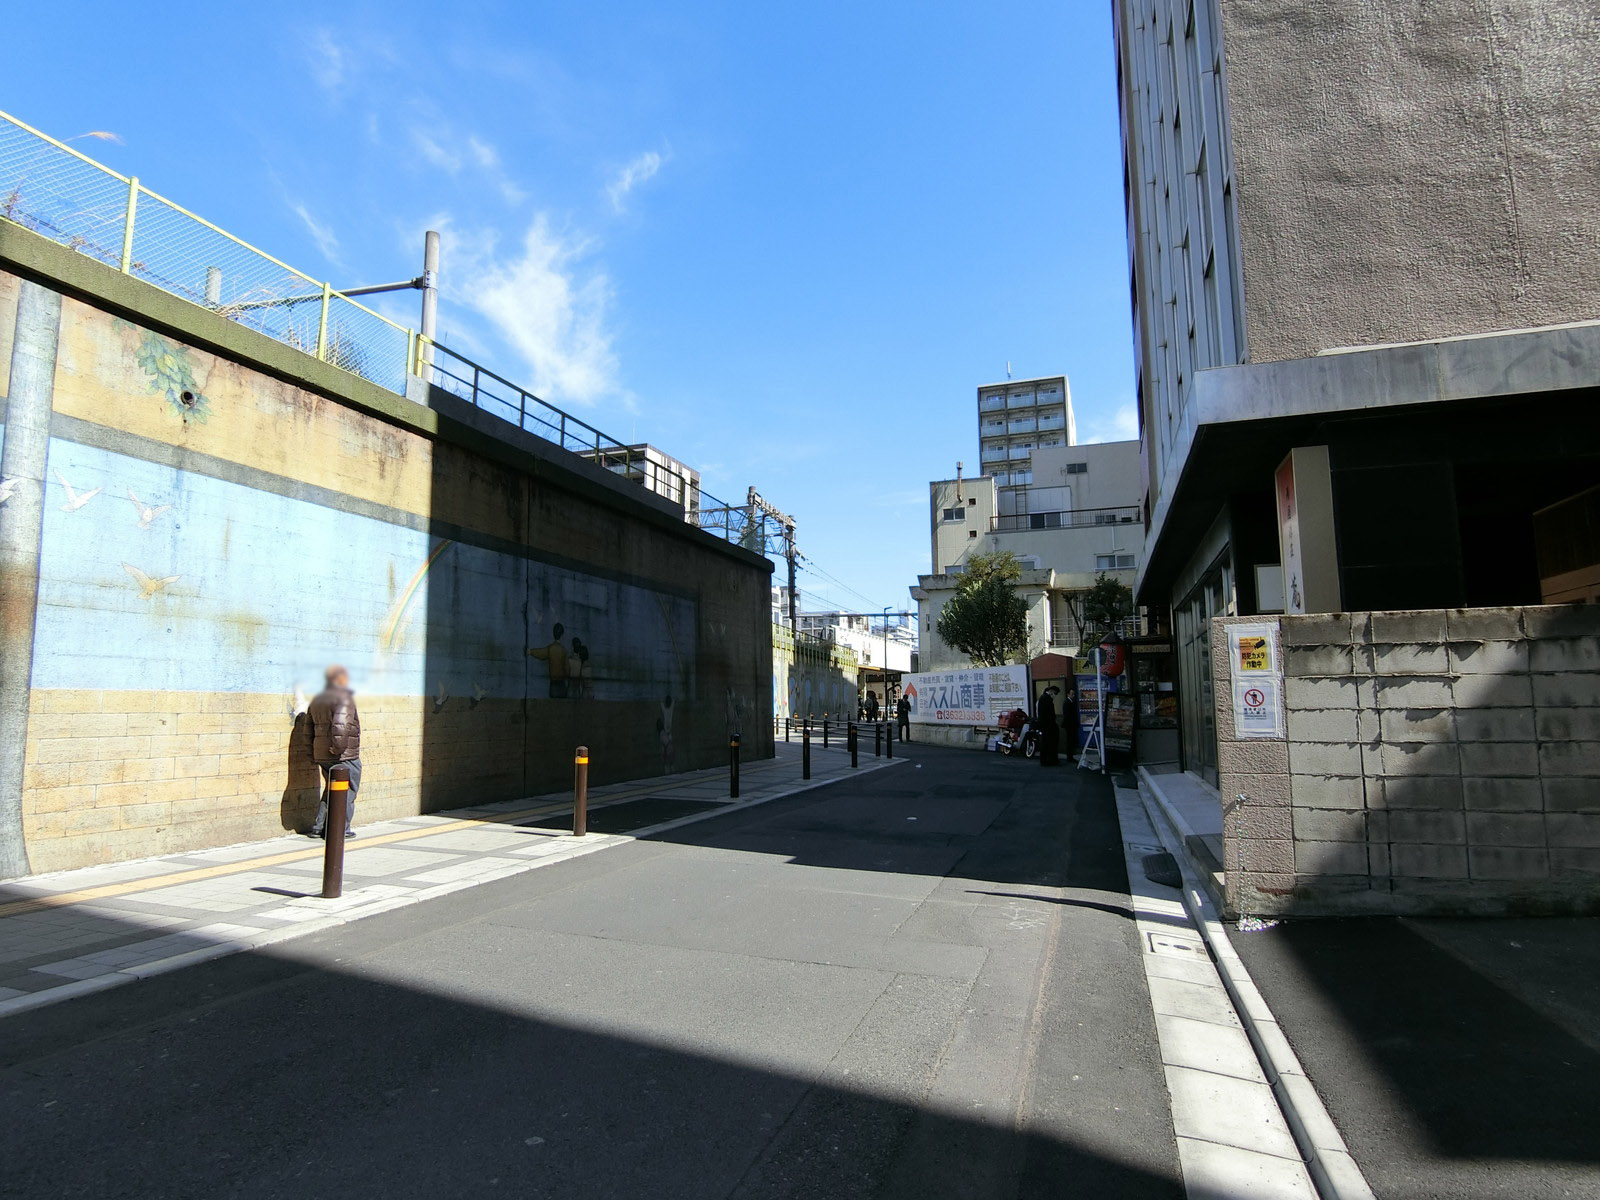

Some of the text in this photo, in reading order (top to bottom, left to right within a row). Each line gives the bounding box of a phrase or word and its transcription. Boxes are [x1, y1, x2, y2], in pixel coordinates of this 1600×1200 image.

[1241, 652, 1265, 660] 防犯カメラ
[928, 683, 986, 709] ススム商事
